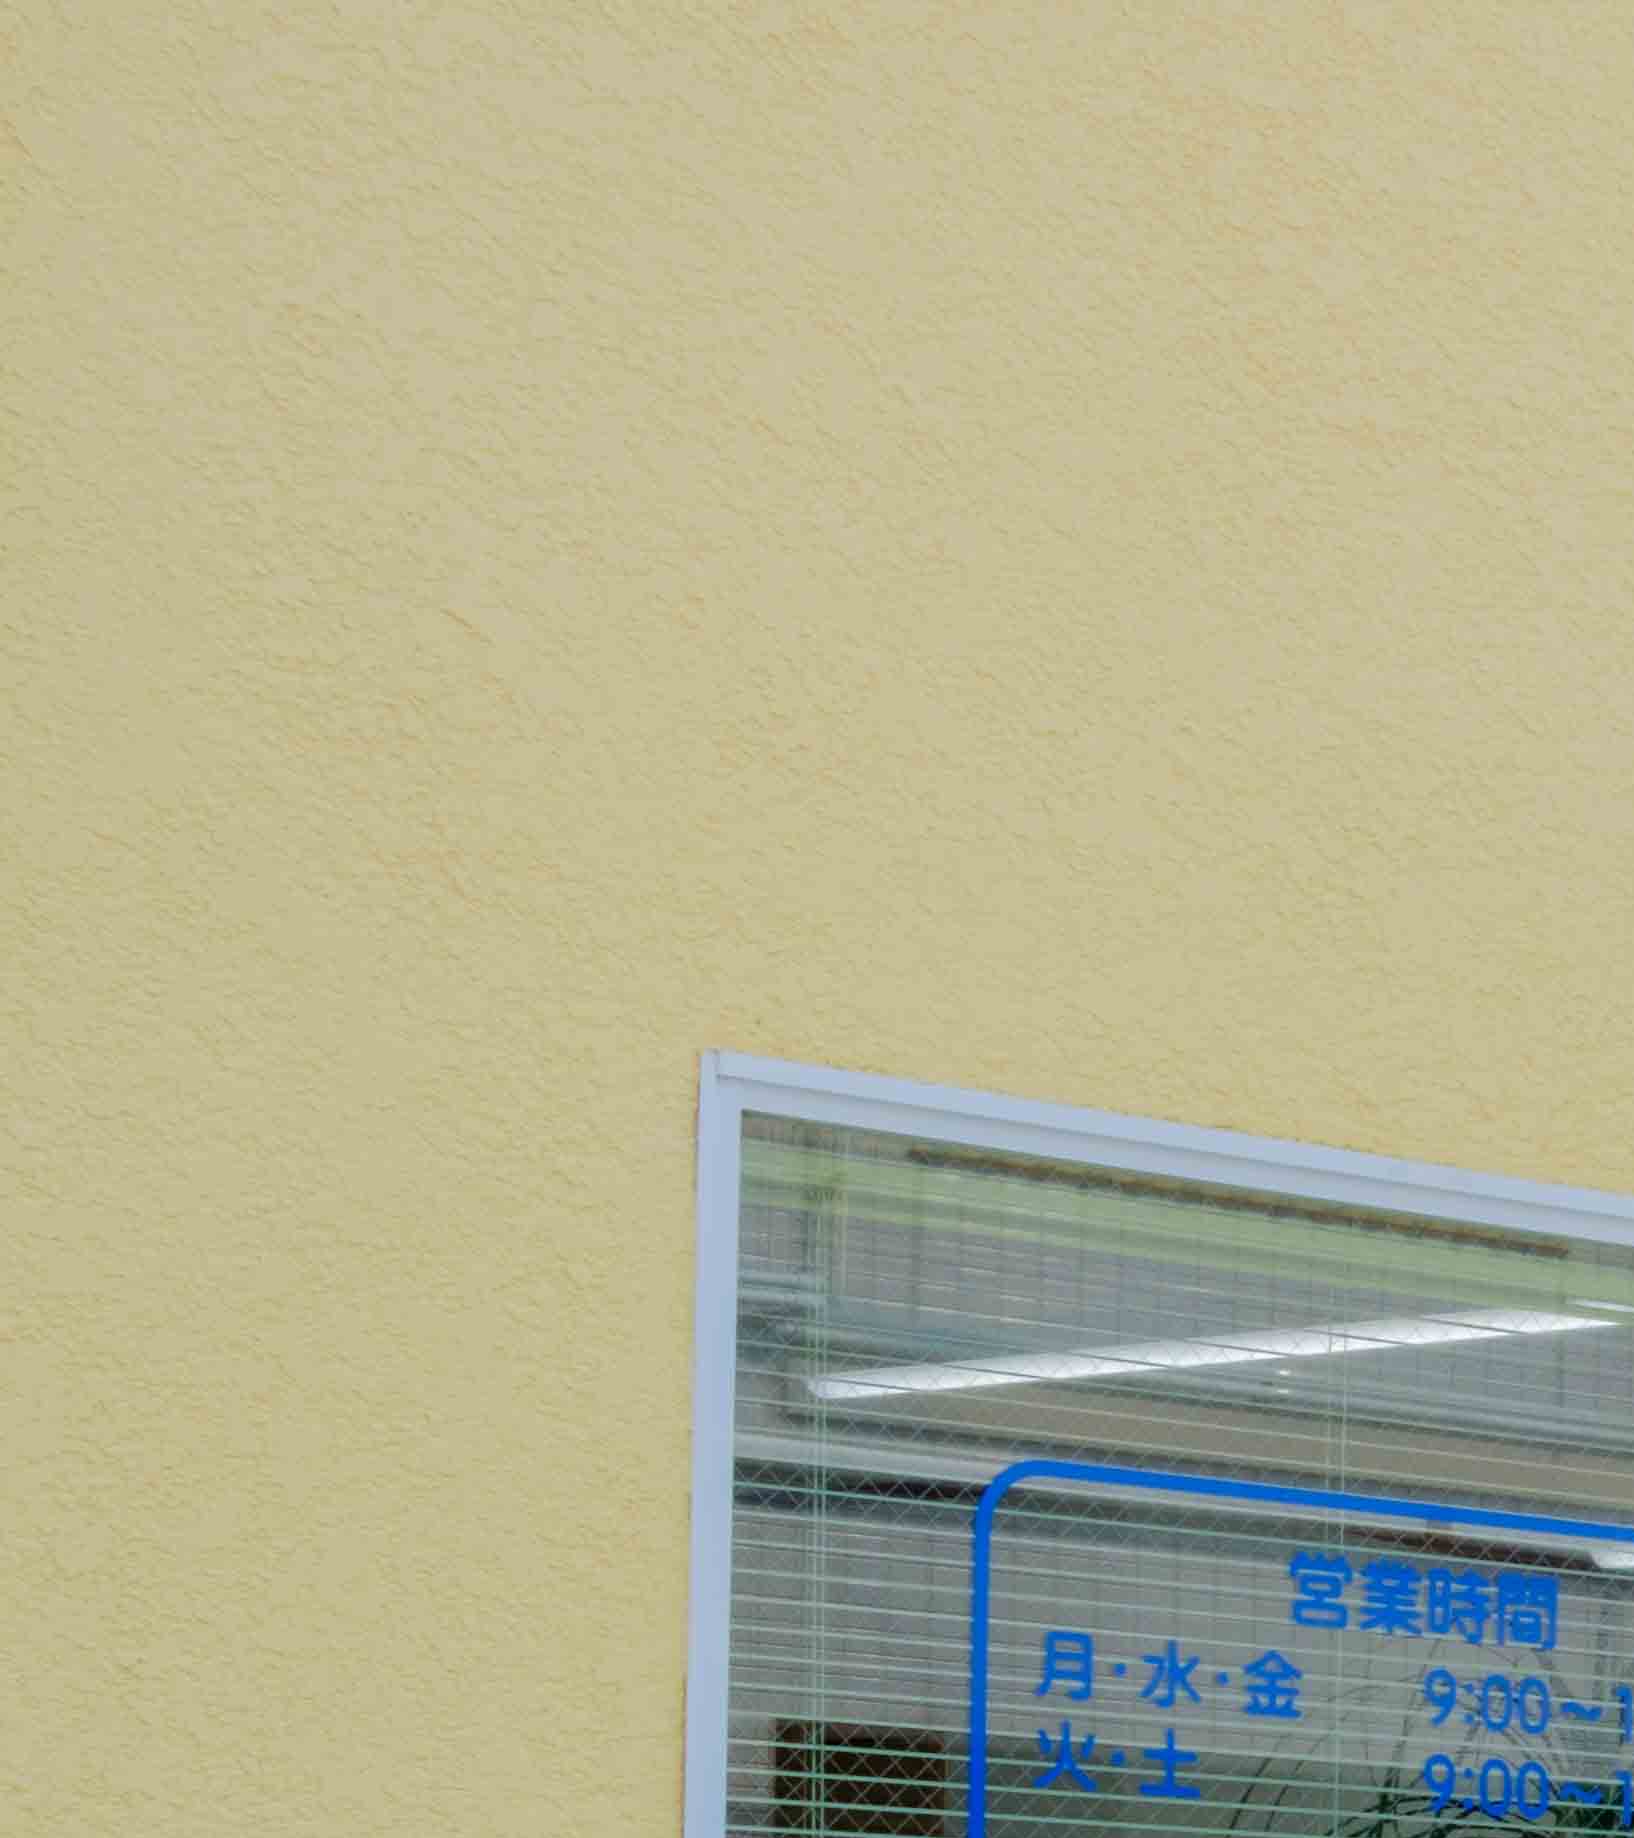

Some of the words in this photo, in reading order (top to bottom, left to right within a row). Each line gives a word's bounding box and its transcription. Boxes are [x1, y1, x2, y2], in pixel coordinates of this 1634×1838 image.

[1288, 1553, 1558, 1651] 営業時間
[1036, 1631, 1301, 1718] 月・水・金
[1034, 1720, 1199, 1797] 火・土
